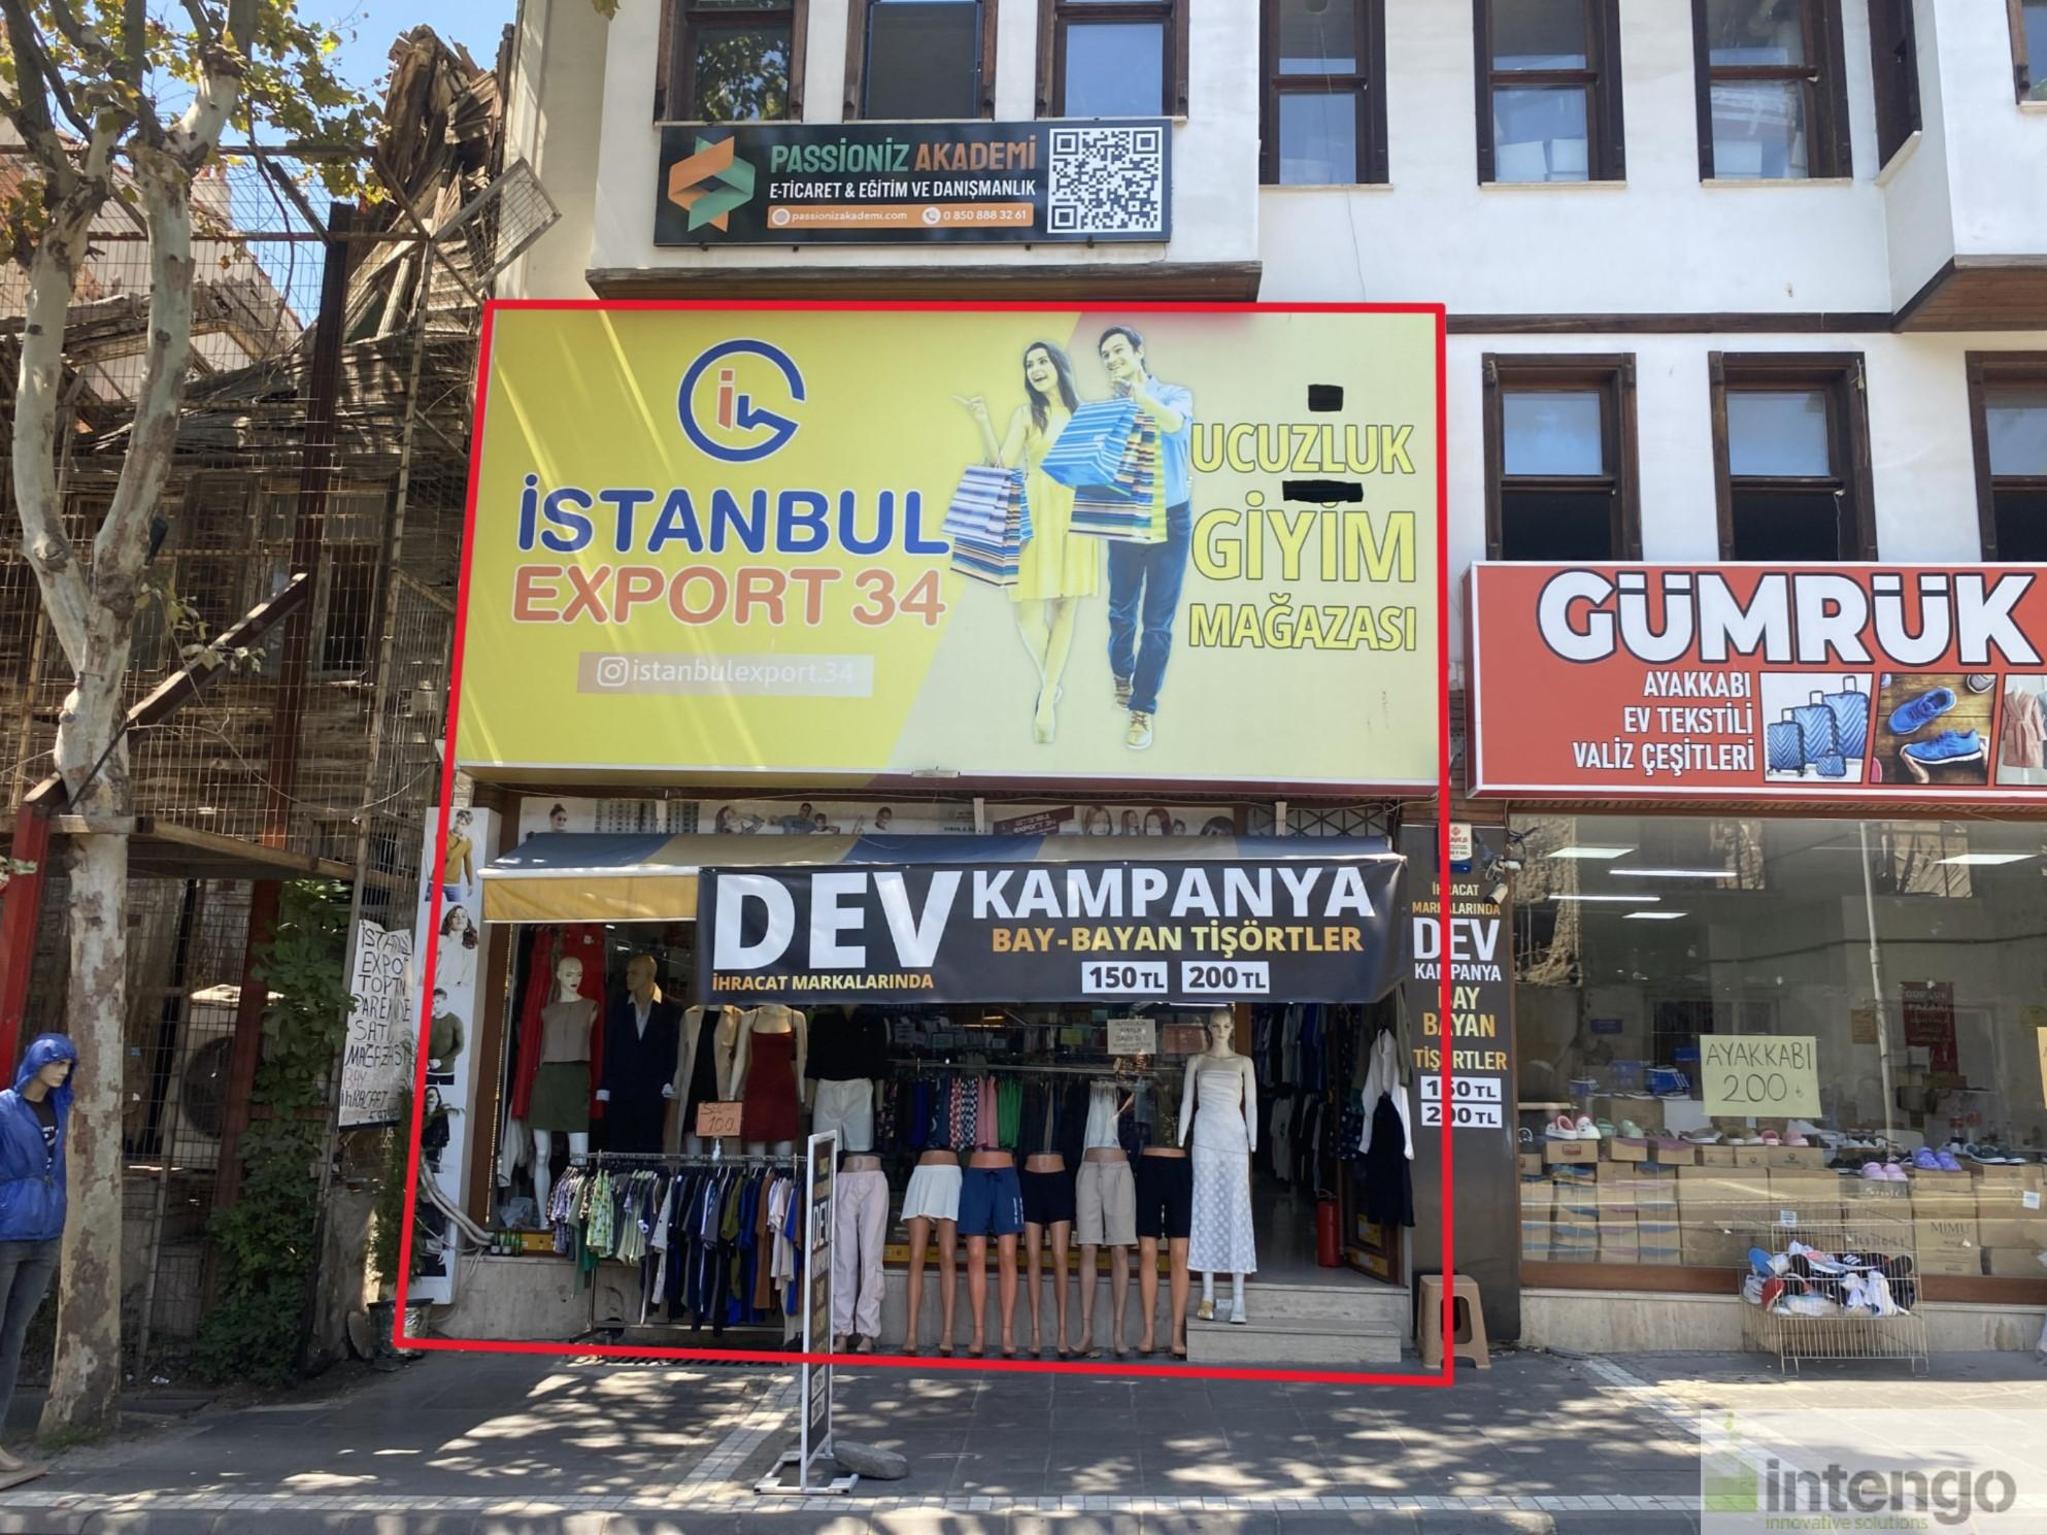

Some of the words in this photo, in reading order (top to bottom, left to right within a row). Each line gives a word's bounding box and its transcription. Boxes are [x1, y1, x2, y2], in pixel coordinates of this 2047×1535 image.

[770, 137, 910, 173] PASSİONİZ
[914, 134, 1037, 172] AKADEMİ
[769, 182, 842, 199] E-TİCARET
[845, 182, 855, 198] &
[859, 179, 908, 198] EĞİTİM
[912, 181, 930, 198] VE
[934, 179, 1036, 199] DANIŞMANLIK
[792, 210, 908, 223] passionizakademi.com
[953, 210, 974, 221] 850
[976, 209, 997, 220] 888
[999, 209, 1013, 220] 32
[1015, 209, 1026, 220] 61
[1190, 422, 1416, 475] UCUZLUK
[517, 473, 951, 556] İSTANBUL
[1190, 490, 1417, 583] GİYİM
[511, 563, 842, 626] EXPORT
[850, 568, 948, 627] 34
[1189, 592, 1417, 652] MAĞAZASI
[1535, 567, 2046, 666] GÜMRÜK
[631, 658, 855, 685] istanbulexport.34
[1643, 671, 1752, 699] AYAKKABI
[1623, 706, 1650, 734] EV
[1657, 702, 1753, 735] TEKSTİLİ
[1571, 736, 1637, 770] VALİZ
[1641, 738, 1755, 776] ÇEŞİTLERİ
[712, 869, 963, 971] DEV
[972, 866, 1376, 920] KAMPANYA
[991, 926, 1183, 953] BAY-BAYAN
[1191, 918, 1365, 959] TİŞÖRTLER
[1413, 916, 1501, 961] DEV
[712, 973, 788, 991] İHRACAT
[791, 973, 935, 991] MARKALARINDA
[1088, 967, 1137, 990] 150
[1140, 973, 1165, 990] TL
[1188, 966, 1238, 989] 200
[1241, 972, 1267, 989] TL
[1415, 962, 1502, 981] KAPANYA
[1412, 1045, 1508, 1072] TİŞRTLER
[1705, 1041, 1812, 1071] AYAKKABI
[1474, 1085, 1497, 1098] TL
[1720, 1072, 1788, 1103] 200
[1475, 1112, 1498, 1124] TL
